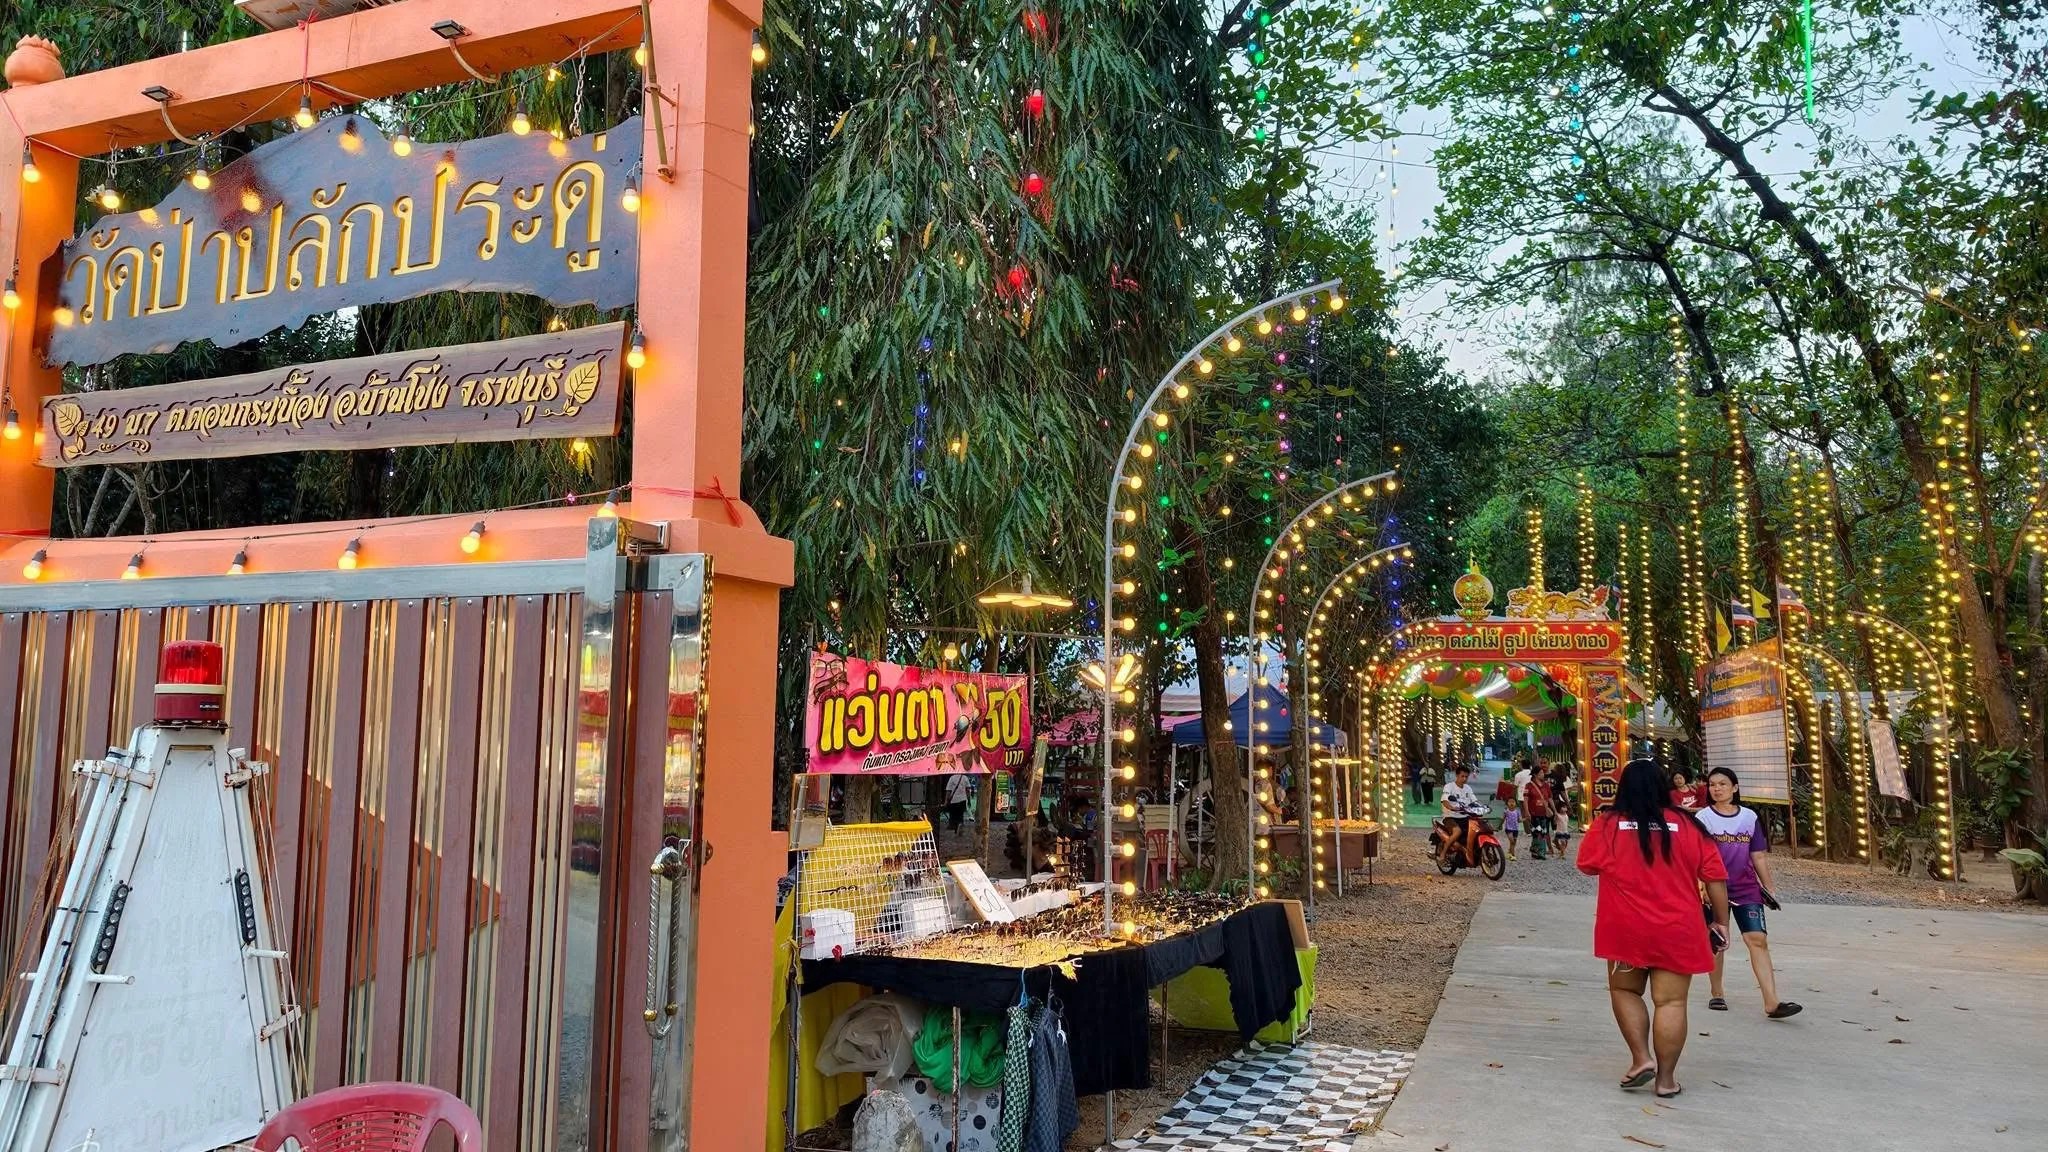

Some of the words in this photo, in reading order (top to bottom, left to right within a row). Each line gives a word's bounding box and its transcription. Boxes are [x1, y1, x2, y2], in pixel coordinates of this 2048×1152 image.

[65, 132, 609, 325] วัดป่าปลักประดู่
[333, 364, 450, 425] อ.บ้านโป่ง
[461, 358, 563, 424] จ.ราชบุรี
[1450, 630, 1499, 649] ดอกไม้
[1505, 634, 1527, 655] ธูป
[1532, 630, 1571, 649] เทียน
[1577, 634, 1608, 649] ทอง
[819, 673, 947, 752] แว่นตา
[979, 690, 1021, 749] 50
[1004, 749, 1024, 767] บาท
